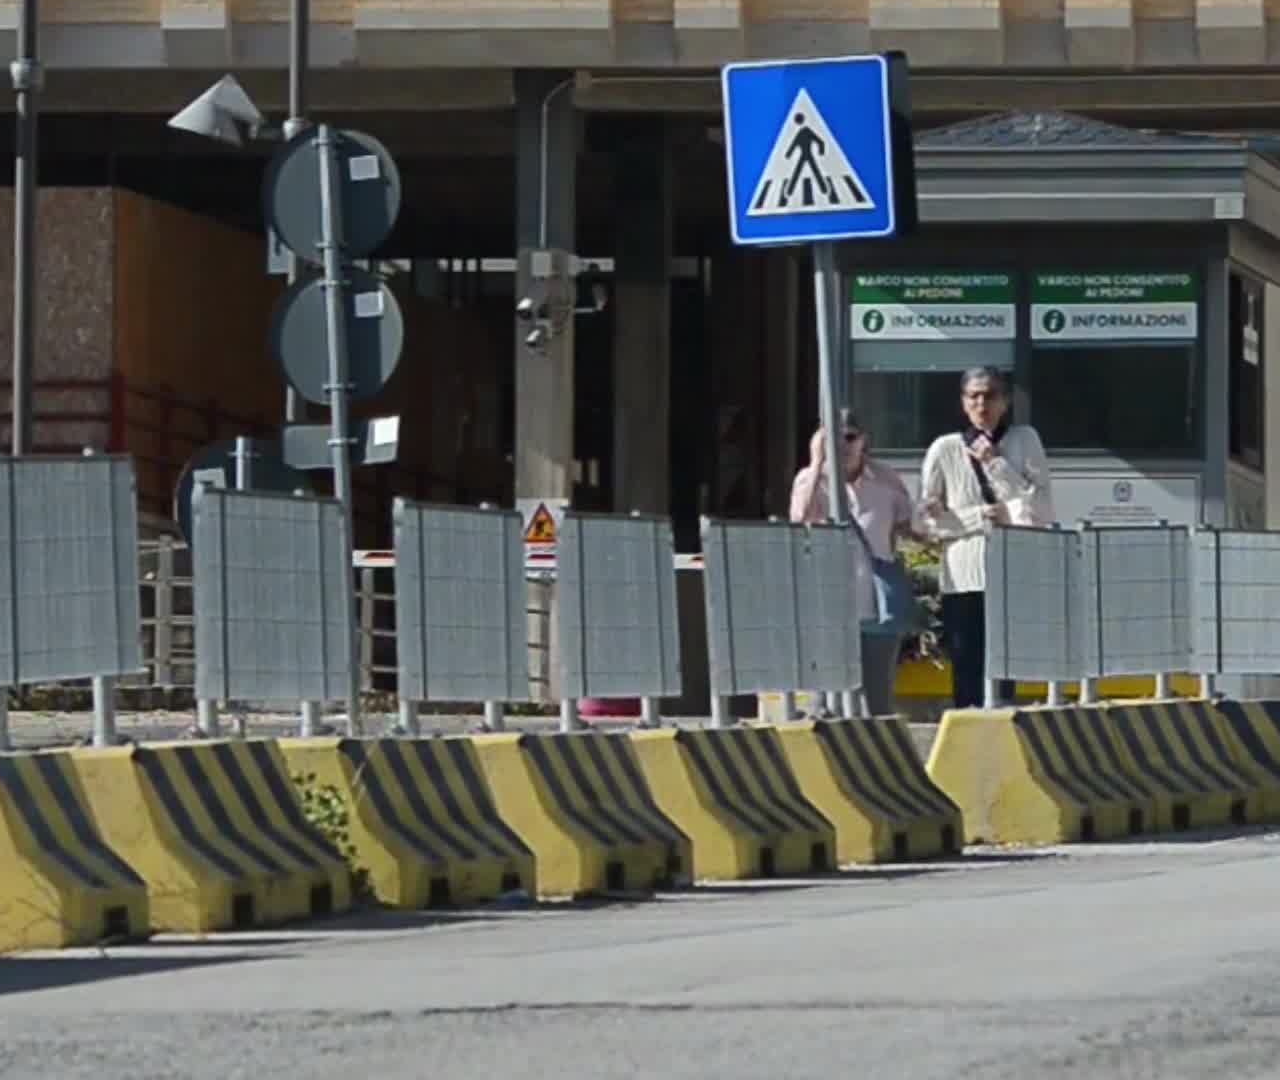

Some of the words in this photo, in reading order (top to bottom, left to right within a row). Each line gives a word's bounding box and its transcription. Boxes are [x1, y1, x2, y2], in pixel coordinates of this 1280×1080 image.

[903, 275, 930, 287] NON
[1037, 274, 1082, 286] VARCO
[1083, 274, 1112, 286] NON
[891, 314, 1005, 328] INFORMAZIONI
[1071, 313, 1187, 328] INFORMAZIONI
